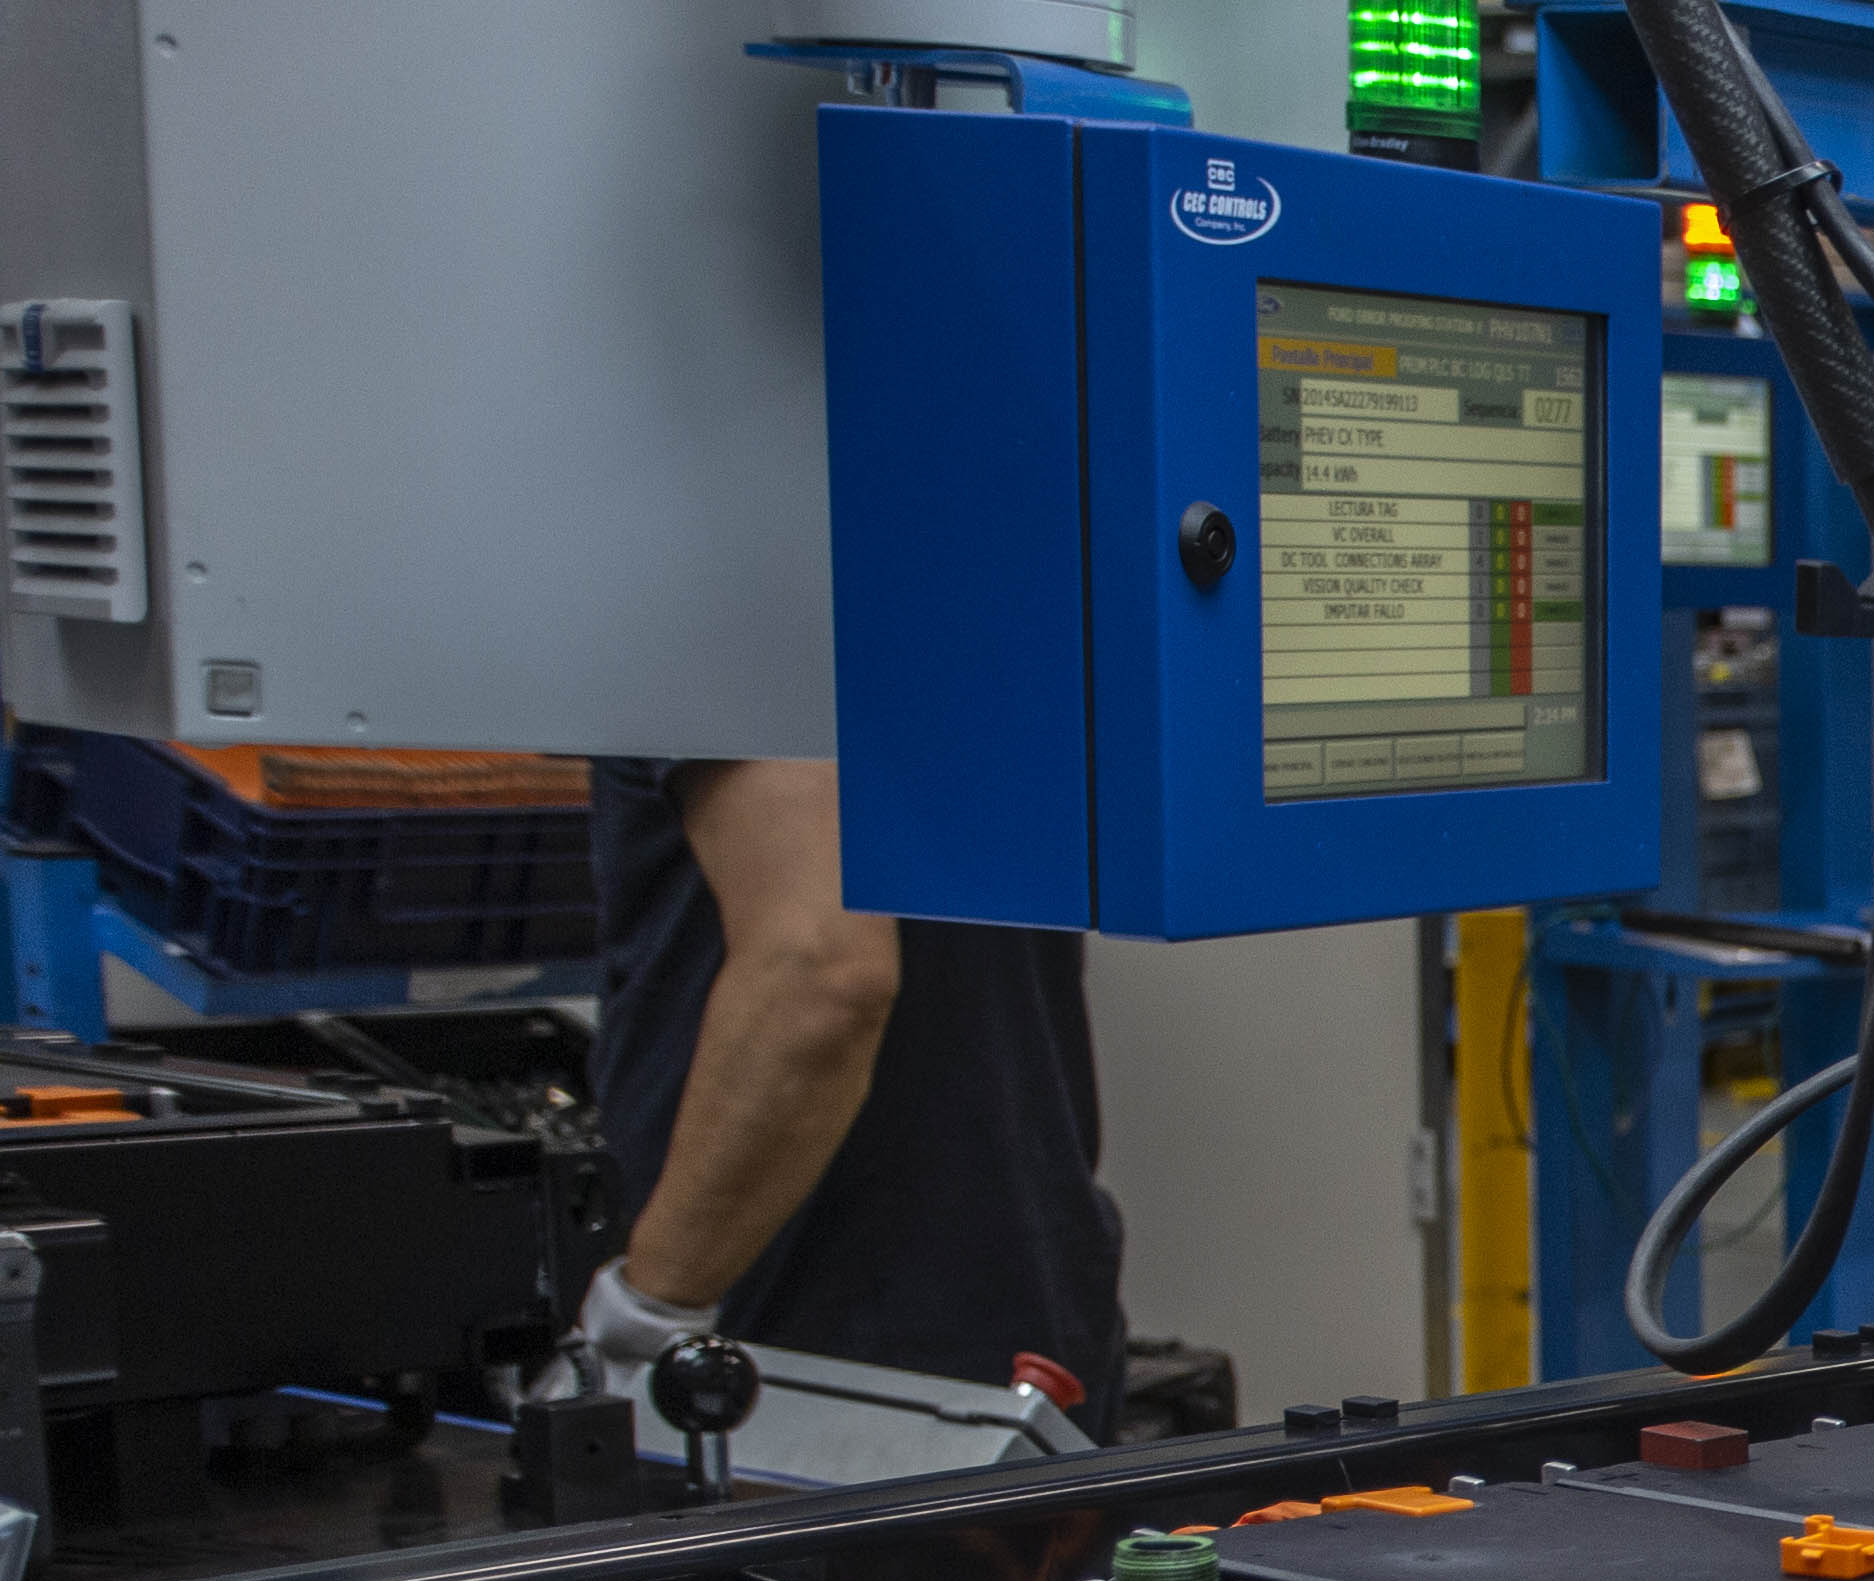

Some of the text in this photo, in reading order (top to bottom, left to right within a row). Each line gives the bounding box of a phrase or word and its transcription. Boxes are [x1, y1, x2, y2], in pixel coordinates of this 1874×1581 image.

[1183, 192, 1267, 220] CEC CONTROLS
[1535, 396, 1572, 423] 0277
[1304, 426, 1334, 445] PHEV
[1355, 429, 1384, 448] TYPE
[1328, 501, 1376, 517] LECTURA
[1378, 503, 1398, 518] TAG
[1350, 527, 1394, 543] OVERALL
[1299, 552, 1329, 568] TOOL
[1335, 553, 1409, 569] CONNECTIONS
[1410, 554, 1443, 569] ARRAY
[1303, 577, 1343, 594] VISION
[1344, 578, 1388, 595] QUALITY
[1390, 579, 1425, 594] CHECK
